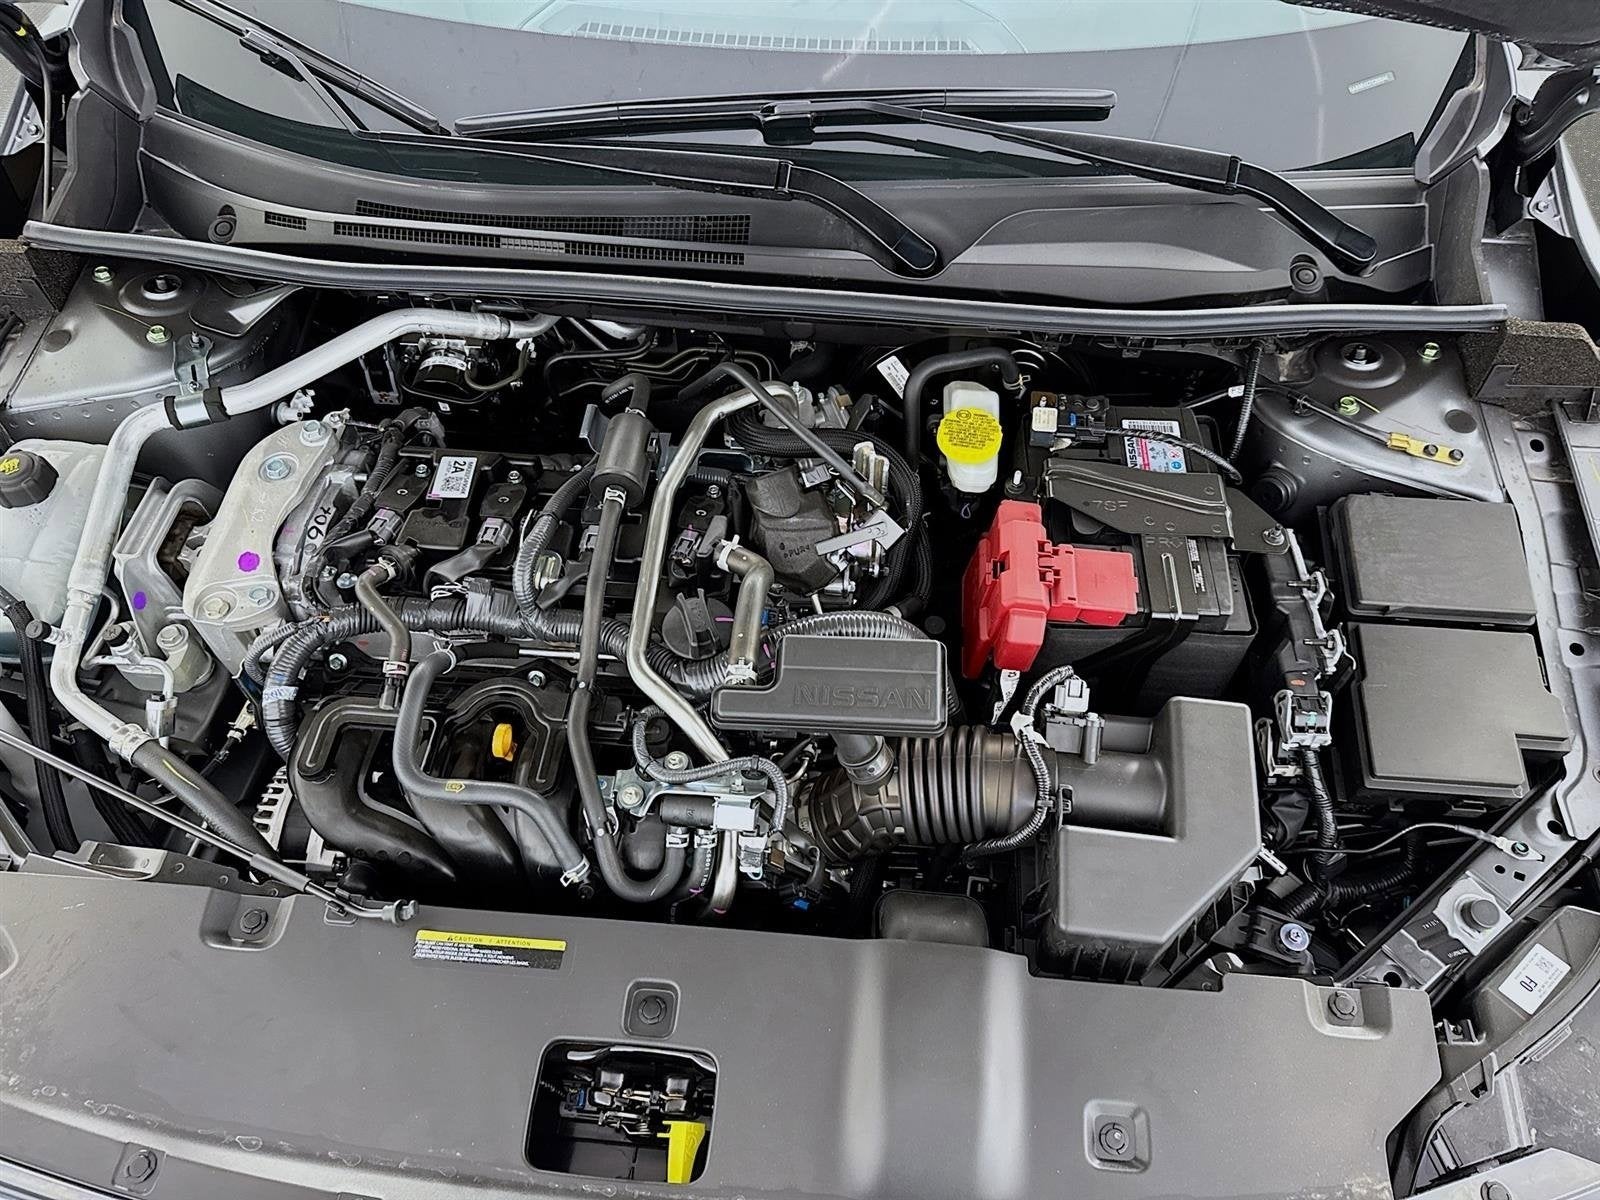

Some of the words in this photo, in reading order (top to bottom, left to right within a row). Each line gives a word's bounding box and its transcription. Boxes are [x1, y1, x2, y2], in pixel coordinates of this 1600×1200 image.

[451, 461, 467, 474] 2A
[794, 682, 932, 709] NISSAN
[454, 935, 483, 943] CAUTION
[496, 938, 531, 947] ATTENTION
